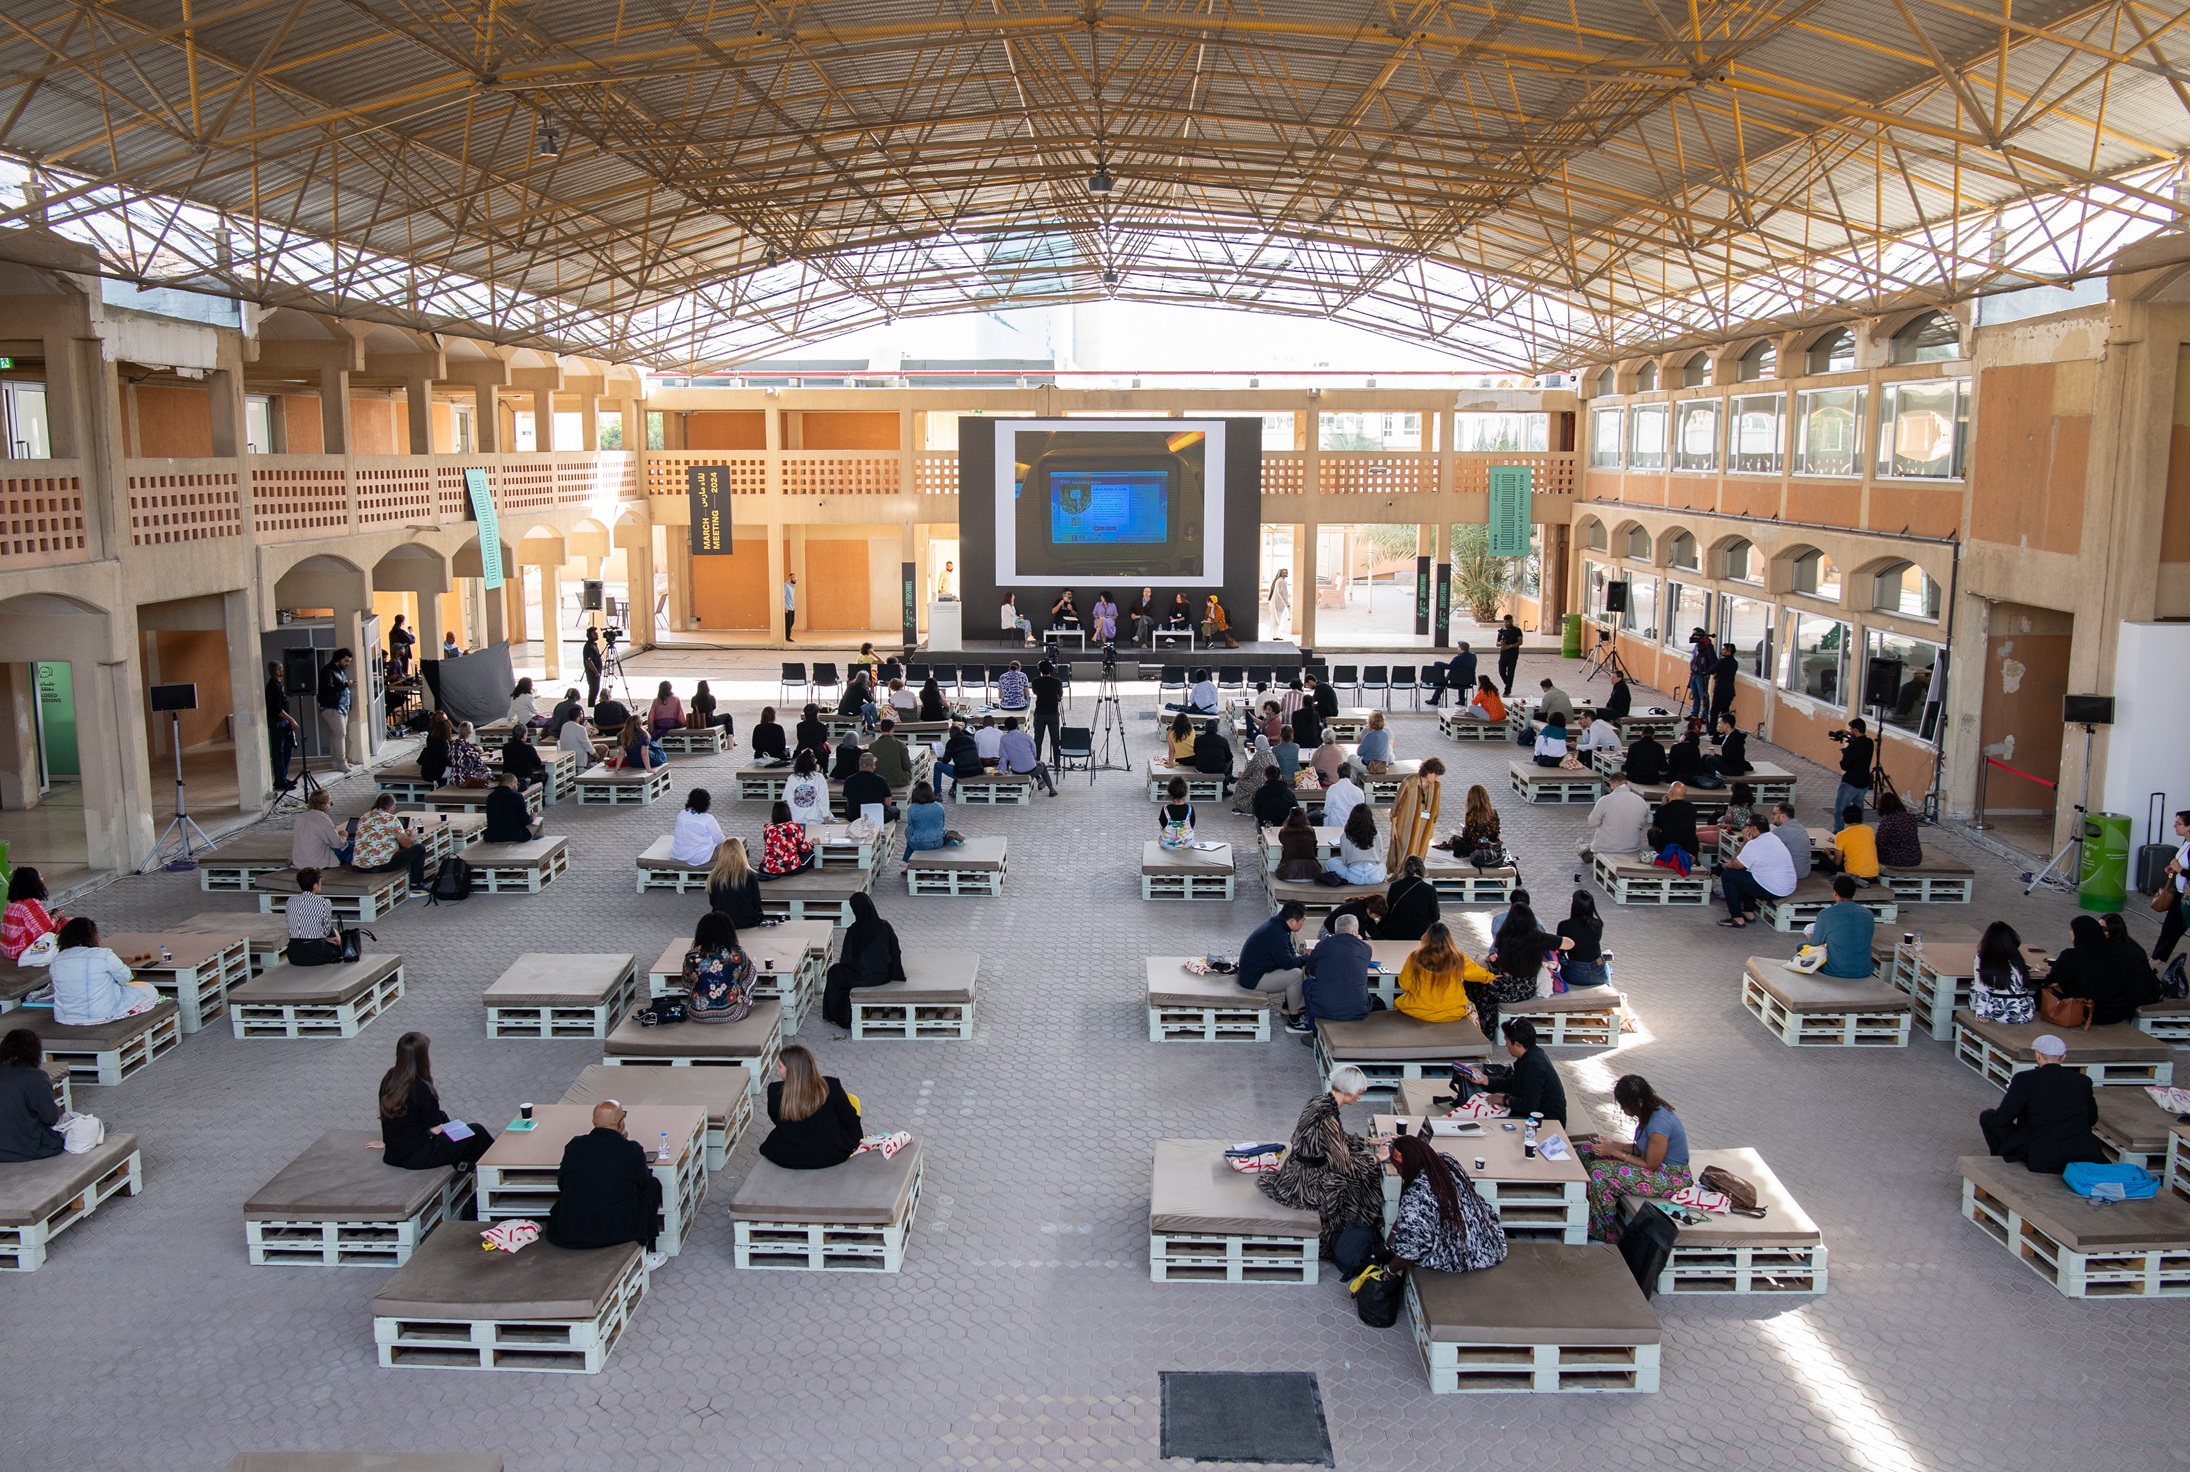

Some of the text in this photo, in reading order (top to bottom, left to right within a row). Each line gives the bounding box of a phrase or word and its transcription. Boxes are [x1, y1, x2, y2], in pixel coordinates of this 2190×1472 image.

[699, 486, 708, 508] مارس
[702, 518, 710, 550] MARCH
[712, 510, 720, 550] MEETING
